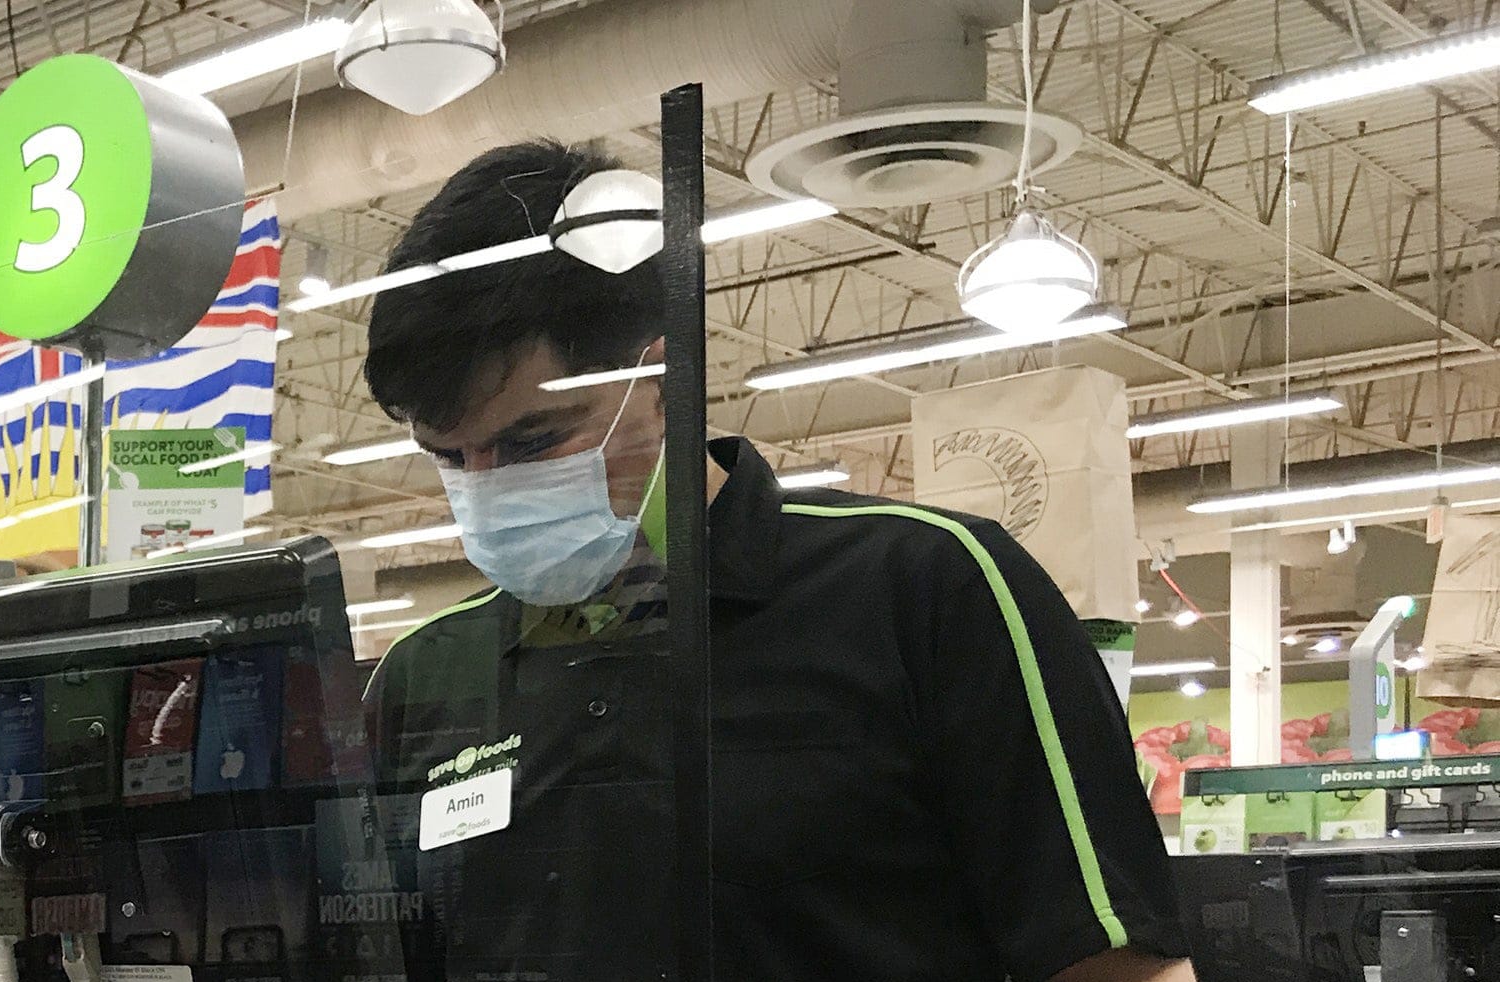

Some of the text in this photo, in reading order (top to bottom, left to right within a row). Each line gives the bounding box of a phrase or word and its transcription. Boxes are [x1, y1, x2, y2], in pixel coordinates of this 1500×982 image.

[13, 123, 87, 273] 3
[113, 440, 214, 452] SUPPORT YOUR
[113, 454, 159, 465] LOCAL
[160, 454, 199, 465] FOOD
[476, 733, 522, 761] foods
[1320, 762, 1492, 785] phone and gift cards
[445, 790, 485, 815] Amin
